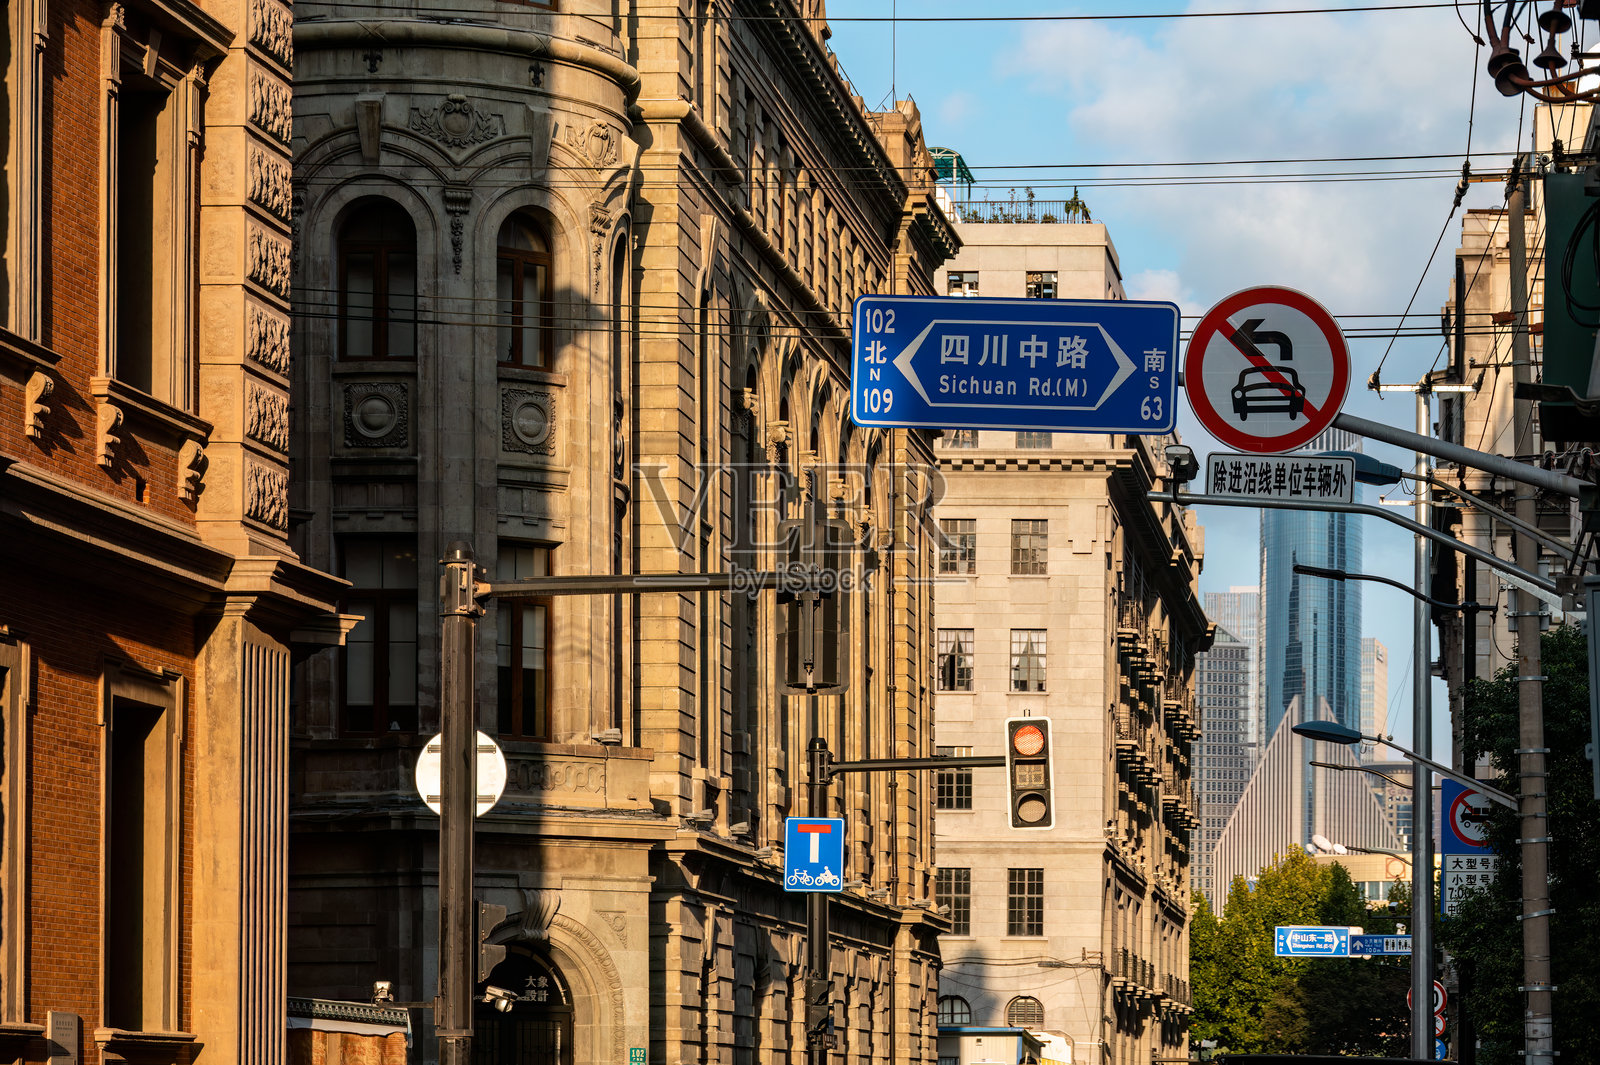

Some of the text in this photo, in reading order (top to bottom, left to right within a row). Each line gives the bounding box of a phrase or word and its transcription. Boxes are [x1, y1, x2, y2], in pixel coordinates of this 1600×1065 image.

[865, 308, 896, 334] 102
[864, 340, 887, 365] 北
[939, 334, 1090, 369] 四川中路
[1143, 348, 1166, 373] 南
[869, 369, 880, 381] N
[939, 374, 1088, 399] Sichuan Rd.(M)
[1149, 376, 1160, 390] S
[863, 387, 894, 414] 109
[1140, 396, 1163, 421] 63
[1213, 460, 1348, 499] 除进沿线单位车辆外
[1292, 933, 1334, 943] 中山东一路
[631, 1049, 645, 1058] 102
